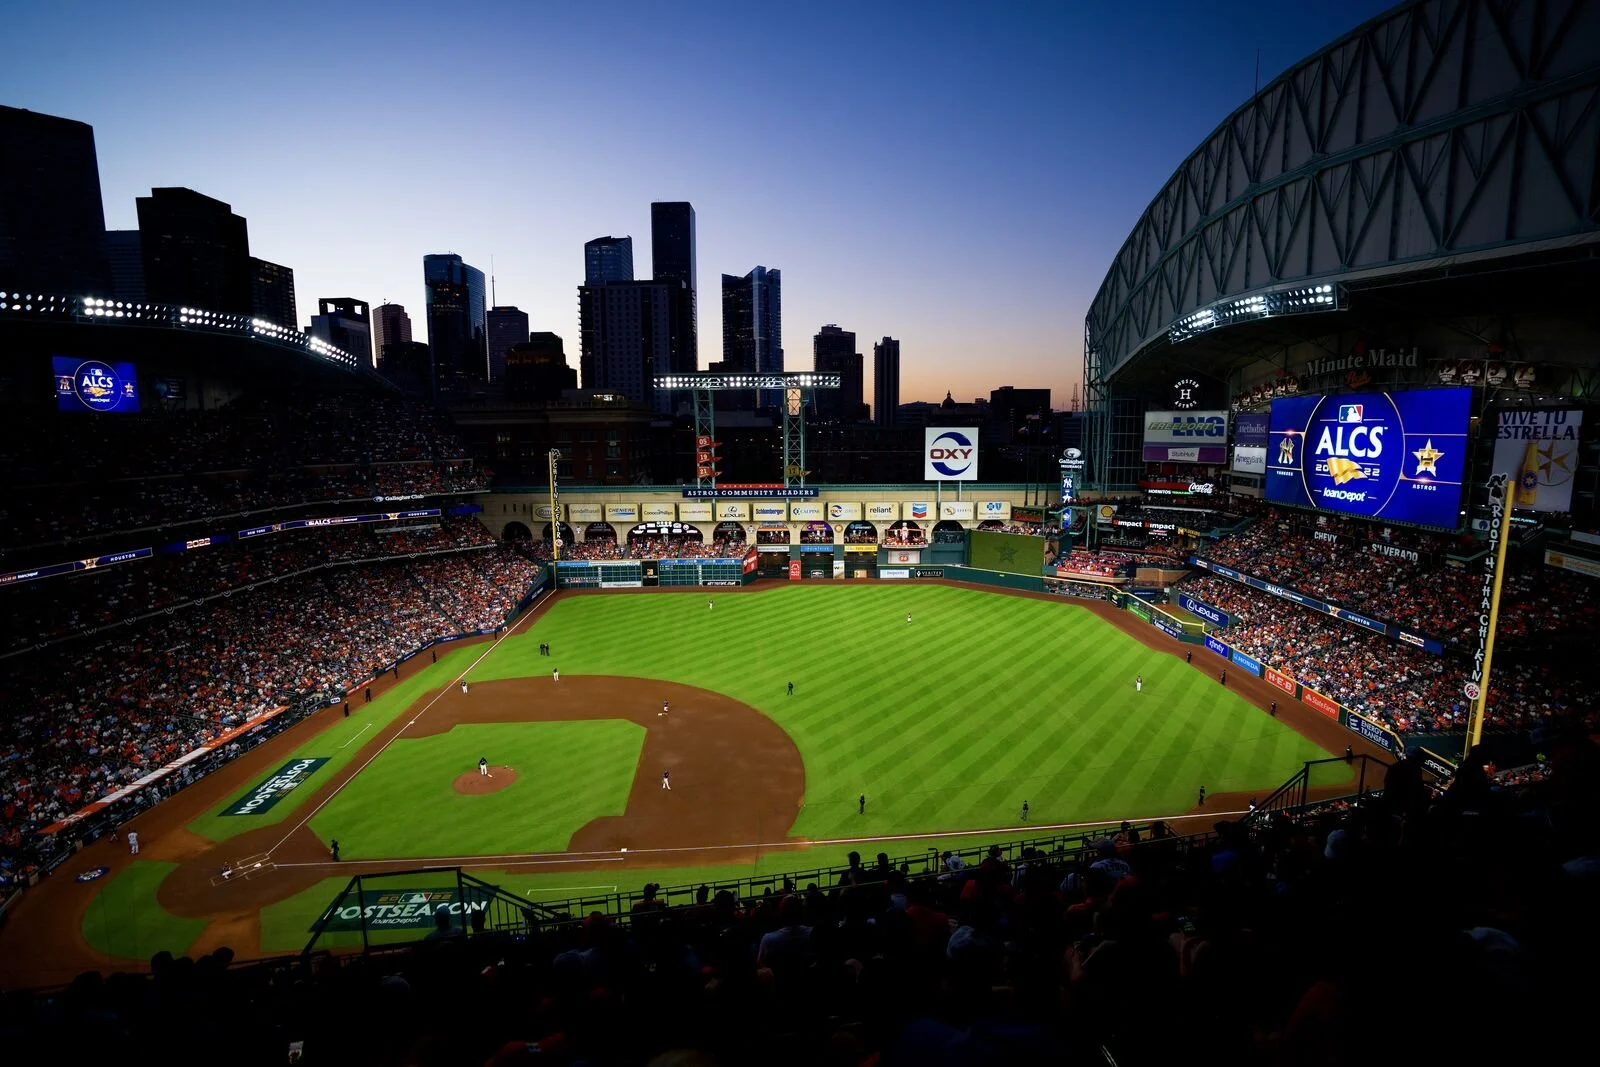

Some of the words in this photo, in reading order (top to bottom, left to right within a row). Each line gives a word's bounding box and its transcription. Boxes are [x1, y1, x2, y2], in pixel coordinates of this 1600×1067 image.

[1305, 355, 1364, 378] Minute
[1367, 346, 1419, 368] Maid
[82, 376, 114, 388] ALCS
[1174, 379, 1200, 389] HOUSTON
[1180, 389, 1192, 400] H
[1174, 400, 1197, 409] ASTROS
[1545, 410, 1568, 425] TU
[1149, 422, 1213, 430] FREEPORT
[1173, 416, 1225, 437] LNG
[1315, 425, 1384, 458] ALCS
[930, 448, 973, 460] OXY
[1323, 487, 1368, 502] loanDepot
[1118, 520, 1143, 528] impact
[1149, 522, 1175, 530] impact
[1488, 505, 1503, 551] ROOT
[1314, 530, 1338, 543] CHEVY
[186, 537, 211, 550] 2022
[110, 553, 136, 562] HOUSTON
[1484, 557, 1495, 569] 4
[1271, 585, 1283, 596] ALCS
[1481, 573, 1494, 609] THA
[1194, 604, 1220, 622] LEXUS
[1347, 614, 1371, 626] HOUSTON
[1209, 639, 1225, 653] xfinity
[1399, 631, 1425, 648] 2022
[1471, 614, 1489, 682] CHIKIN
[1237, 655, 1259, 672] HONDA
[1360, 720, 1383, 737] ENERGY
[1359, 726, 1389, 749] TRANSFER
[234, 759, 317, 815] POSTSEASON
[372, 917, 422, 925] loanDepot
